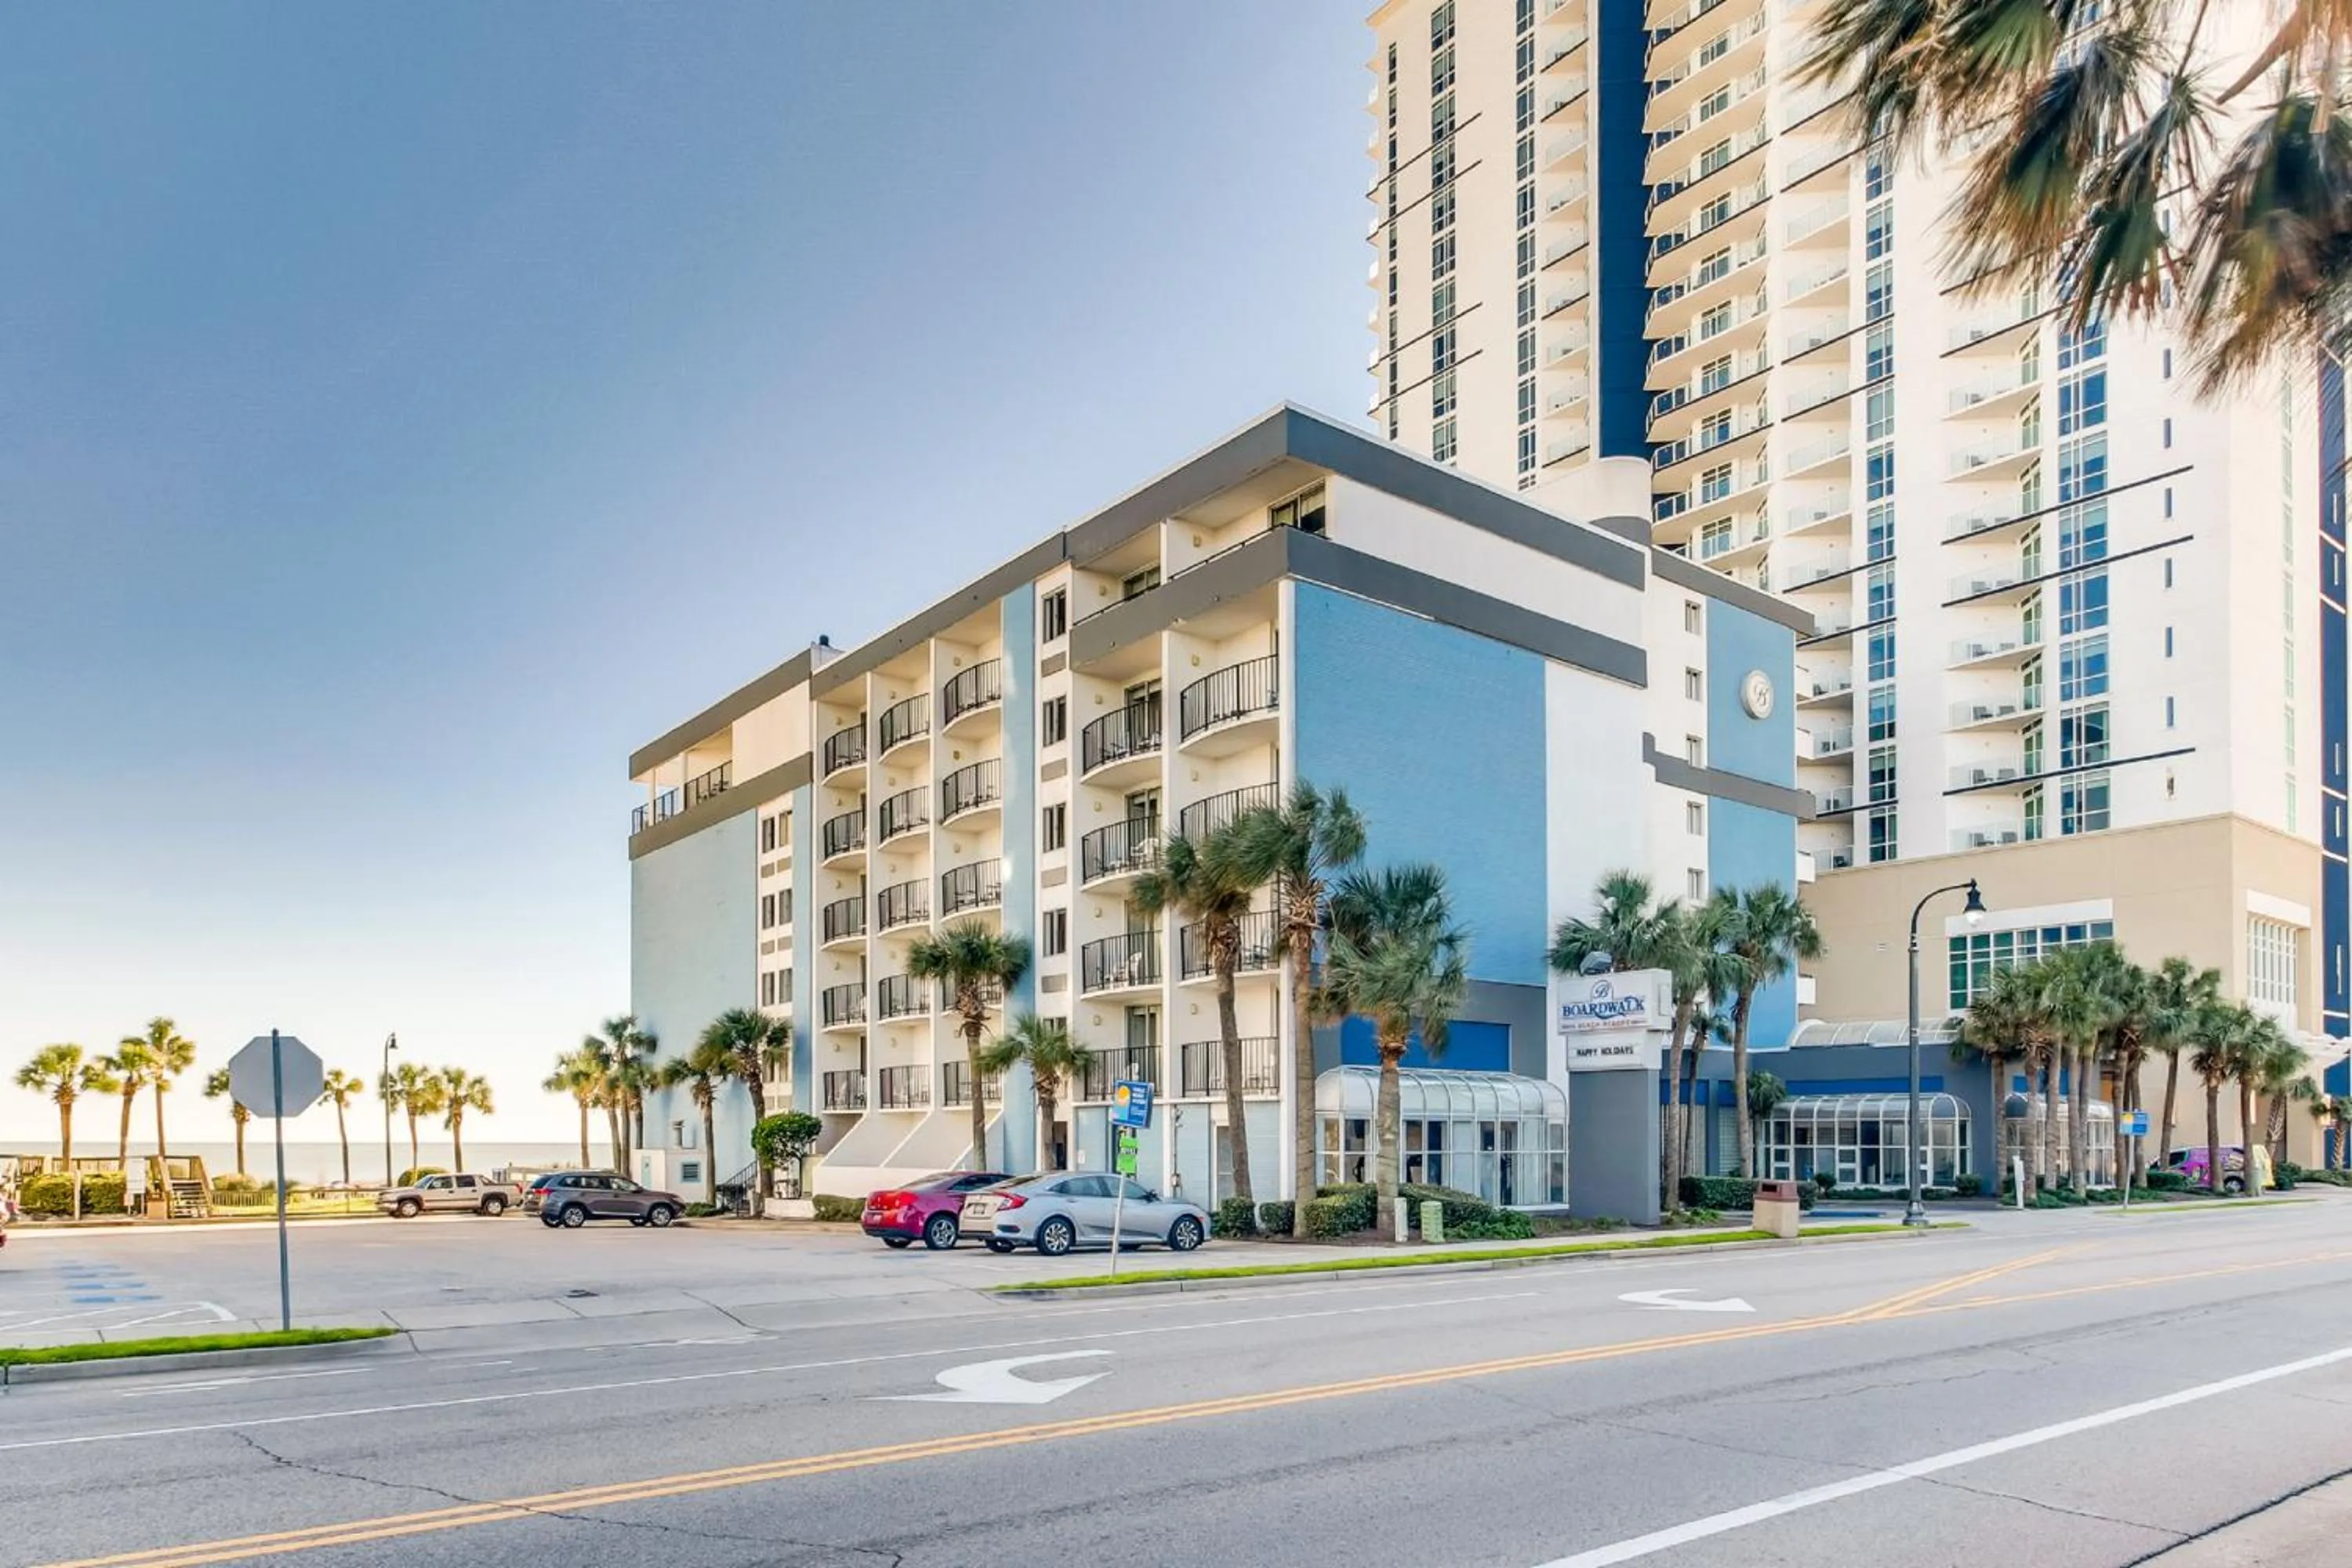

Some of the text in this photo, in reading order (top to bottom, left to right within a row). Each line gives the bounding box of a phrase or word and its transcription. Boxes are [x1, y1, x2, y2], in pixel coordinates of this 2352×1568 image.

[1563, 996, 1645, 1019] BOARDWALK
[1577, 1045, 1634, 1057] HAPPY HOLIDAYS
